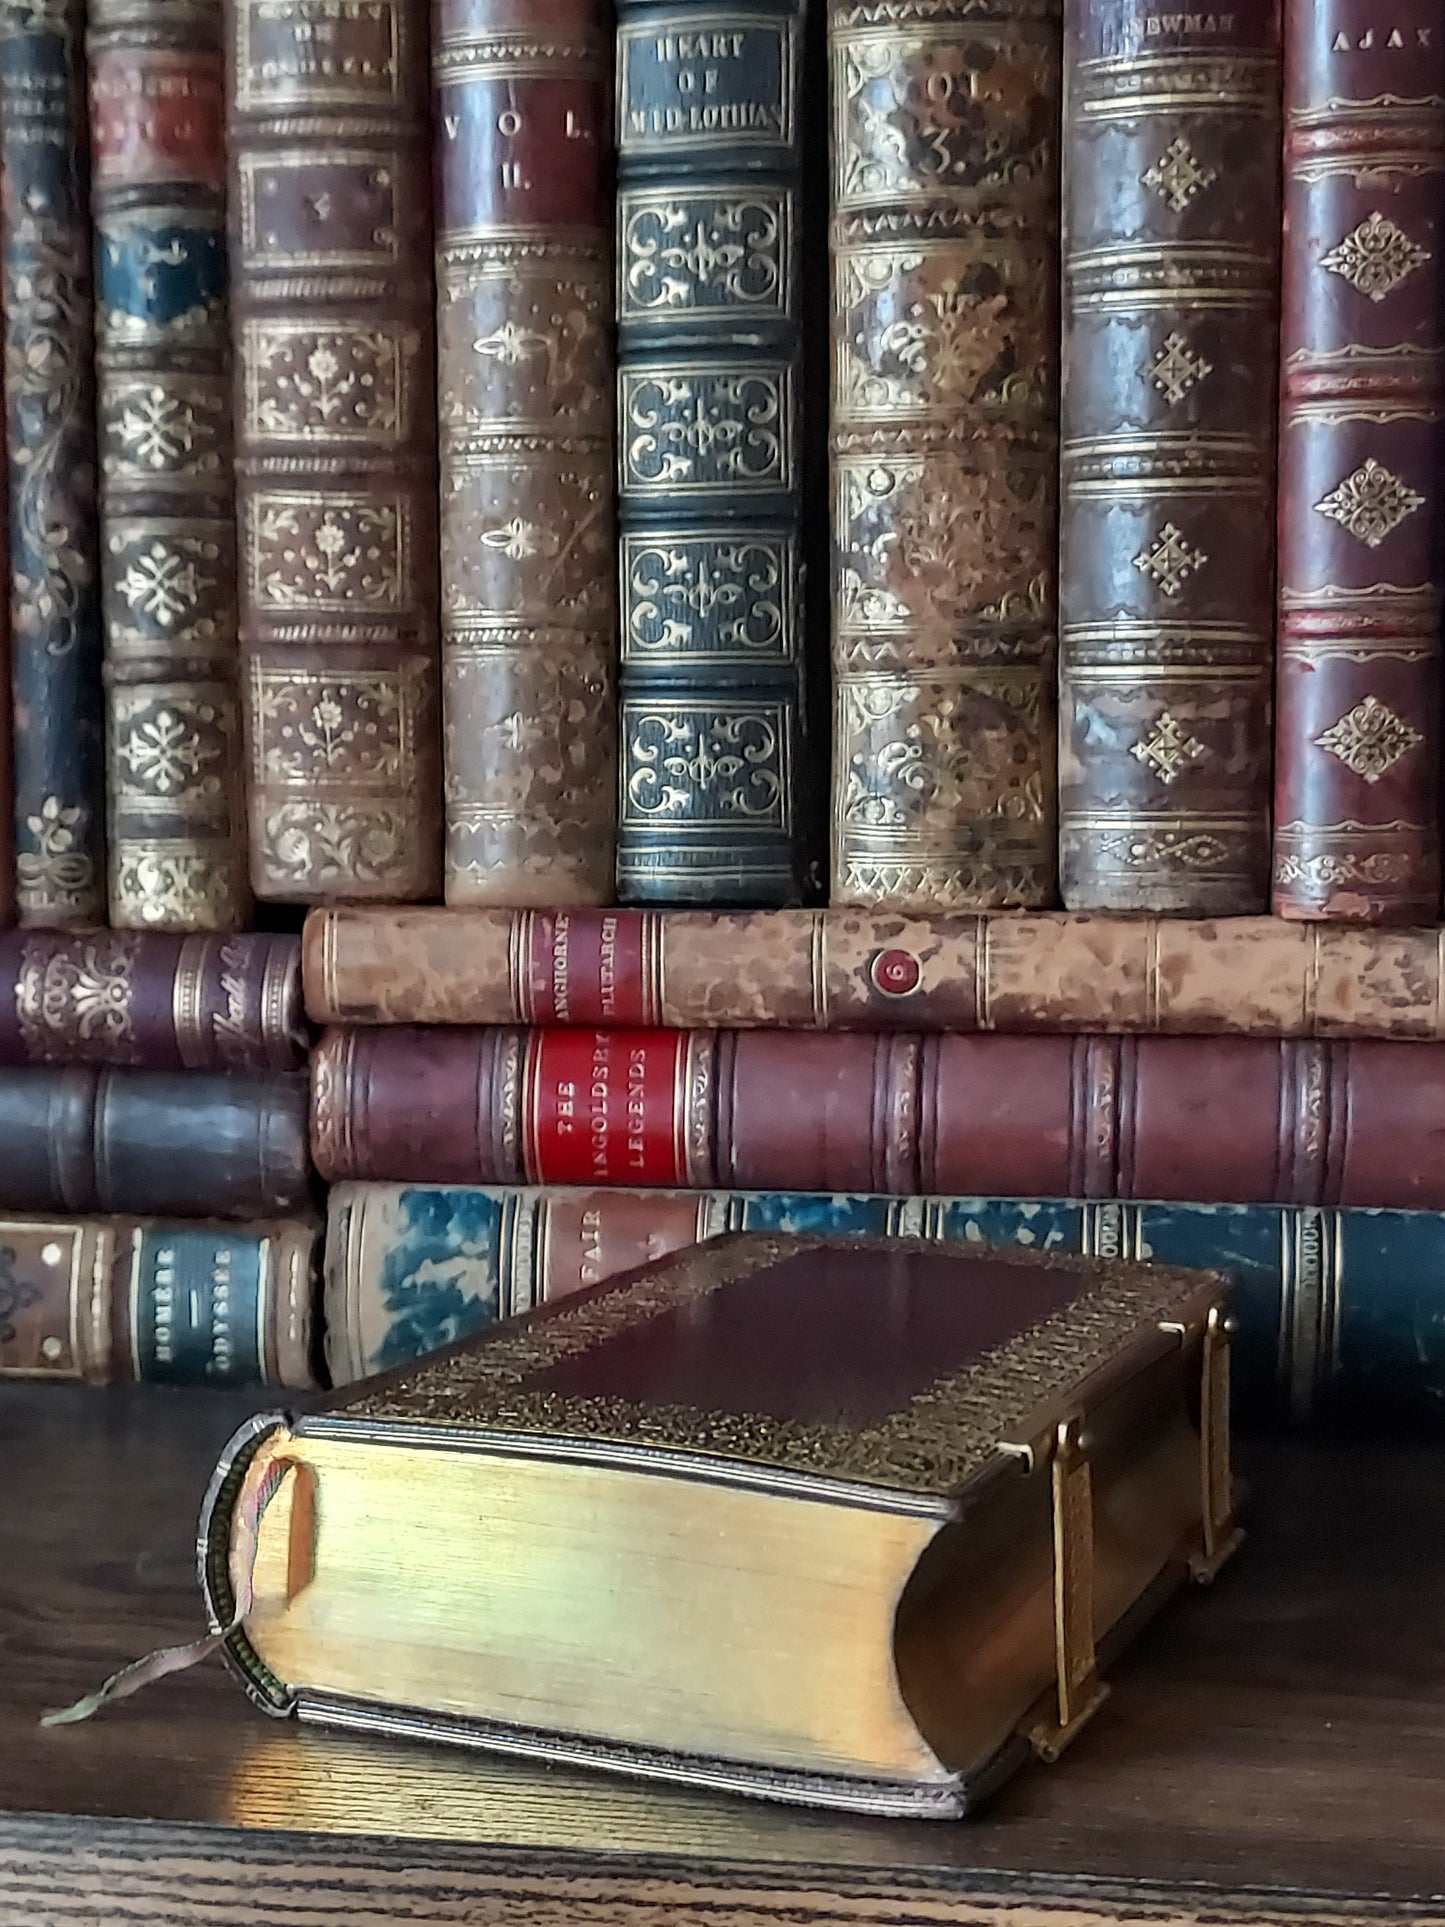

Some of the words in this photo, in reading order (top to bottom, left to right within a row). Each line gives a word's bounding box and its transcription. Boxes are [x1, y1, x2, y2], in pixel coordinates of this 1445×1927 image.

[656, 33, 744, 62] HEART
[1332, 28, 1431, 51] AJAX
[679, 69, 718, 94] OF
[601, 917, 617, 1015] PLUTARCH
[592, 1032, 609, 1176] INGOLDSBY
[628, 1049, 645, 1168] LEGENDS
[582, 1210, 600, 1281] FAIR
